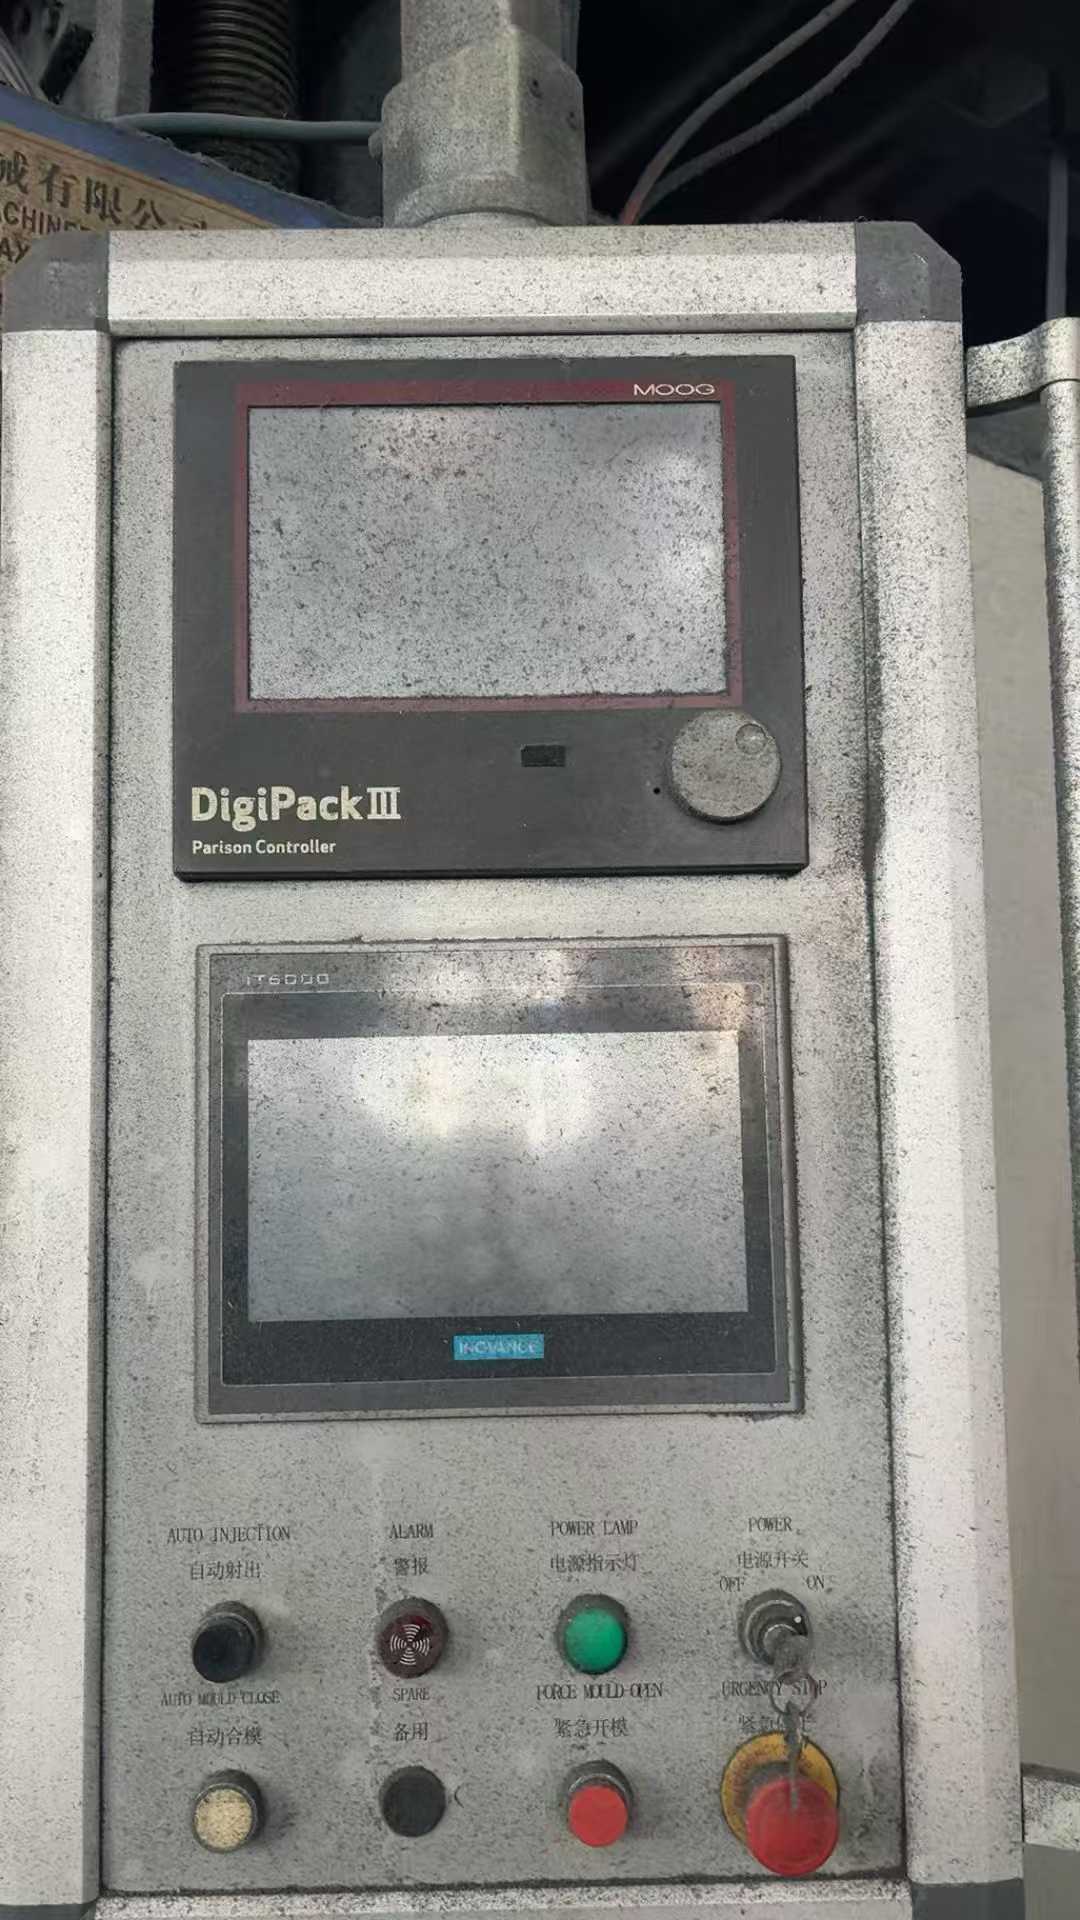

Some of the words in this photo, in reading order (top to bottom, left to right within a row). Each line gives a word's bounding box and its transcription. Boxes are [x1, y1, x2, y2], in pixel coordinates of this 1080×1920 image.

[0, 150, 207, 230] 械有限公
[633, 383, 715, 396] MOOG
[191, 785, 363, 832] DigiPack
[192, 840, 252, 855] Parison
[255, 839, 337, 854] Controller
[389, 1524, 433, 1539] ALARM
[550, 1520, 595, 1536] POWER
[602, 1519, 638, 1536] LAMP
[748, 1516, 792, 1532] POWER
[167, 1527, 203, 1543] AUTO
[211, 1524, 291, 1543] INJECTION
[393, 1557, 429, 1576] 警报
[550, 1552, 639, 1573] 电源指示灯
[738, 1551, 808, 1569] 电源开关
[190, 1560, 261, 1580] 自动射出
[719, 1575, 745, 1593] OFF
[806, 1575, 825, 1592] ON
[161, 1691, 192, 1706] AUTO
[198, 1691, 236, 1706] MOULD
[241, 1690, 280, 1704] CLOSE
[393, 1687, 430, 1701] SPARE
[537, 1683, 577, 1700] FORCE
[584, 1683, 624, 1699] MOULD
[630, 1681, 663, 1697] OPEN
[189, 1726, 262, 1747] 自动合模
[395, 1722, 429, 1742] 备用
[553, 1719, 629, 1739] 紧急开模
